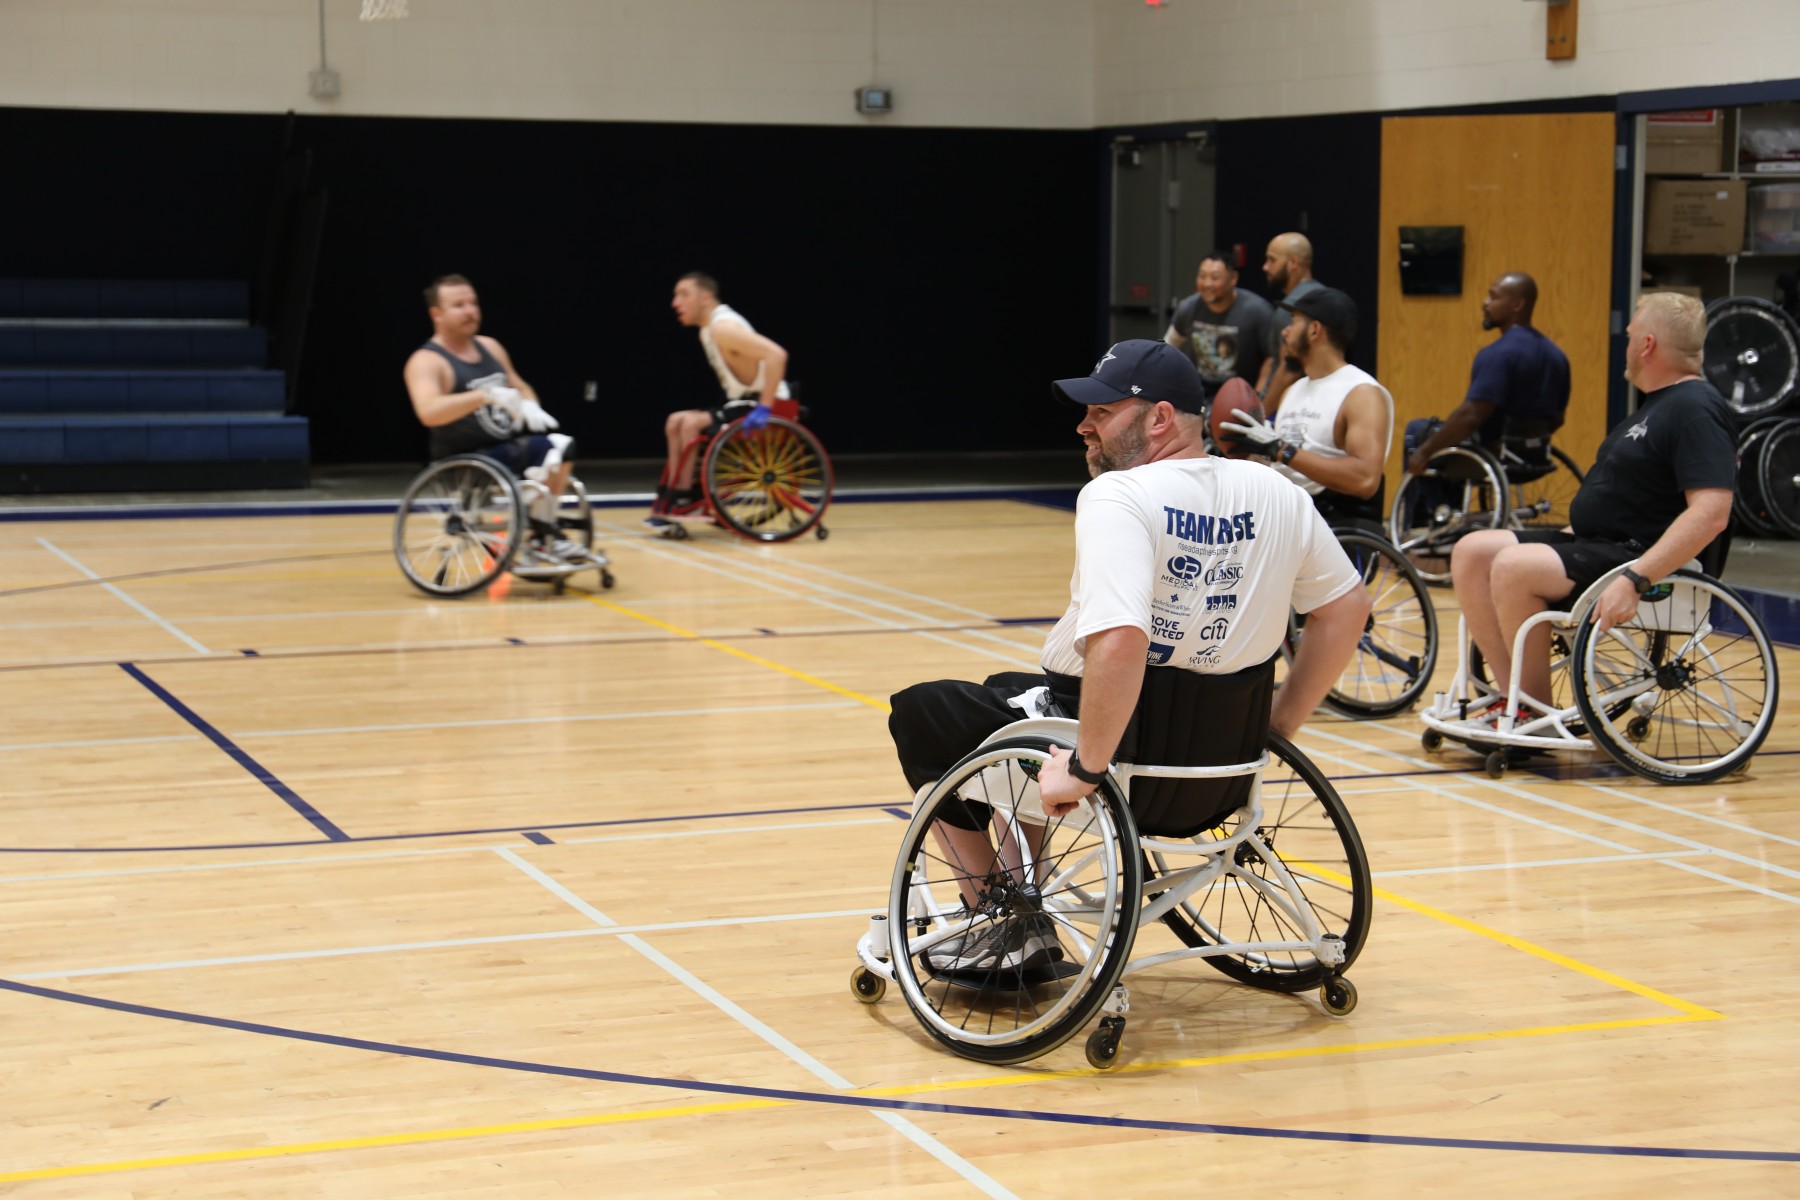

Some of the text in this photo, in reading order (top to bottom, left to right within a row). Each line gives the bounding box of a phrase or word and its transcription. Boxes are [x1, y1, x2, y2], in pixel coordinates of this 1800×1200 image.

[1163, 505, 1215, 545] TEAM
[1204, 566, 1244, 586] CLASSIC
[1151, 625, 1185, 640] NITED
[1200, 620, 1228, 640] citi
